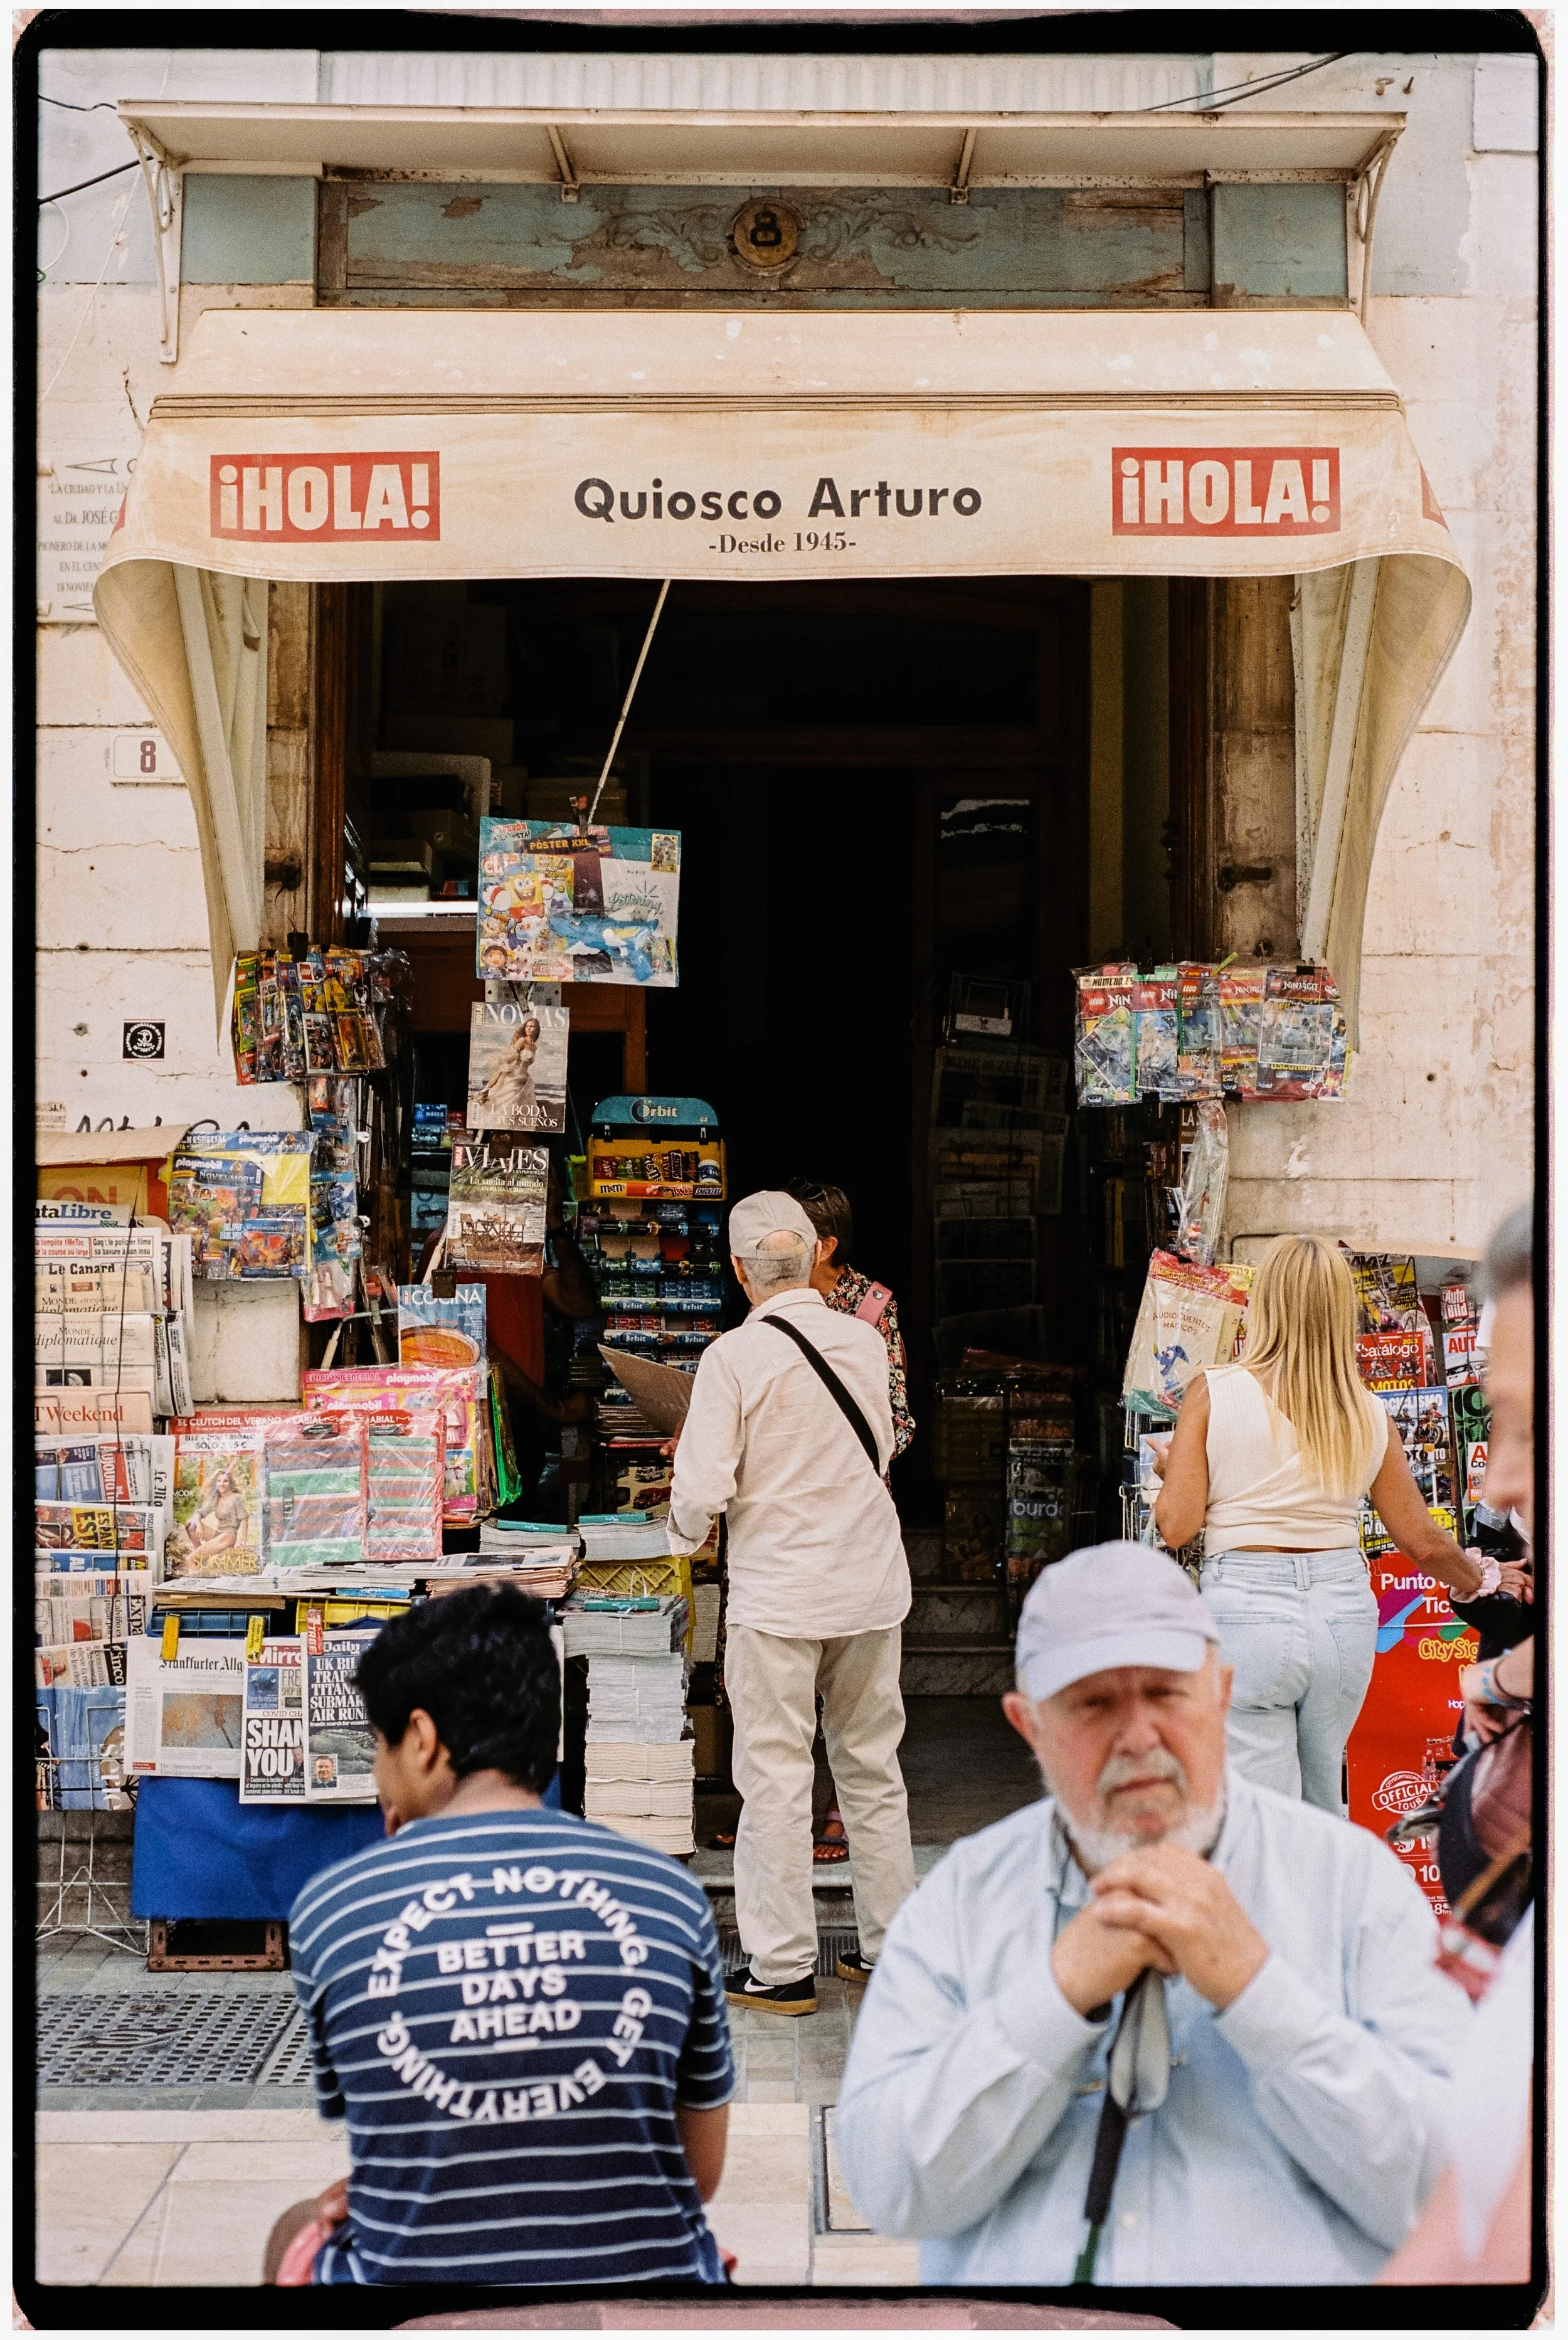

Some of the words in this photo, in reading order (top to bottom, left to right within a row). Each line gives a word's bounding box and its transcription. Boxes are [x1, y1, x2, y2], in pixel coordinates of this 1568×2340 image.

[751, 211, 781, 246] 8
[64, 484, 95, 494] CIUDAD
[97, 484, 103, 494] Y
[219, 464, 432, 530] ¡HOLA!
[1120, 457, 1330, 524] ¡HOLA!
[574, 477, 782, 523] Quiosco
[807, 477, 982, 517] Arturo
[81, 506, 107, 525] JOSÉ
[73, 541, 84, 551] DE
[709, 532, 785, 553] -Desde
[793, 531, 857, 552] 1945-
[140, 740, 157, 773] 8
[511, 1104, 548, 1118] BODA
[517, 1114, 558, 1128] SUEÑOS
[238, 1134, 280, 1145] playmobil
[176, 1157, 223, 1170] playmobil
[516, 1178, 544, 1188] mundo
[93, 1238, 104, 1247] Gag
[108, 1238, 115, 1246] le
[137, 1238, 152, 1246] filme
[138, 1247, 151, 1256] insu
[48, 1263, 65, 1276] Le
[70, 1263, 115, 1275] Canard
[344, 1372, 381, 1382] ESPECIAL
[386, 1373, 441, 1385] playmobil
[46, 1405, 124, 1422] Weekend
[177, 1419, 188, 1427] EL
[189, 1417, 225, 1427] CLUTCH
[226, 1417, 243, 1426] DEL
[244, 1416, 282, 1425] VERANO
[1380, 1572, 1436, 1591] Punto
[316, 1658, 334, 1670] UK
[312, 1708, 336, 1723] AIR
[246, 1748, 295, 1777] YOU
[1379, 1782, 1436, 1806] OFFICIAL
[1397, 1797, 1423, 1811] TOUR
[437, 1929, 586, 1974] BETTER
[367, 1873, 475, 1999] EXPECT
[604, 1987, 653, 2068] GET
[461, 1964, 567, 2006] DAYS
[449, 1999, 583, 2043] AHEAD
